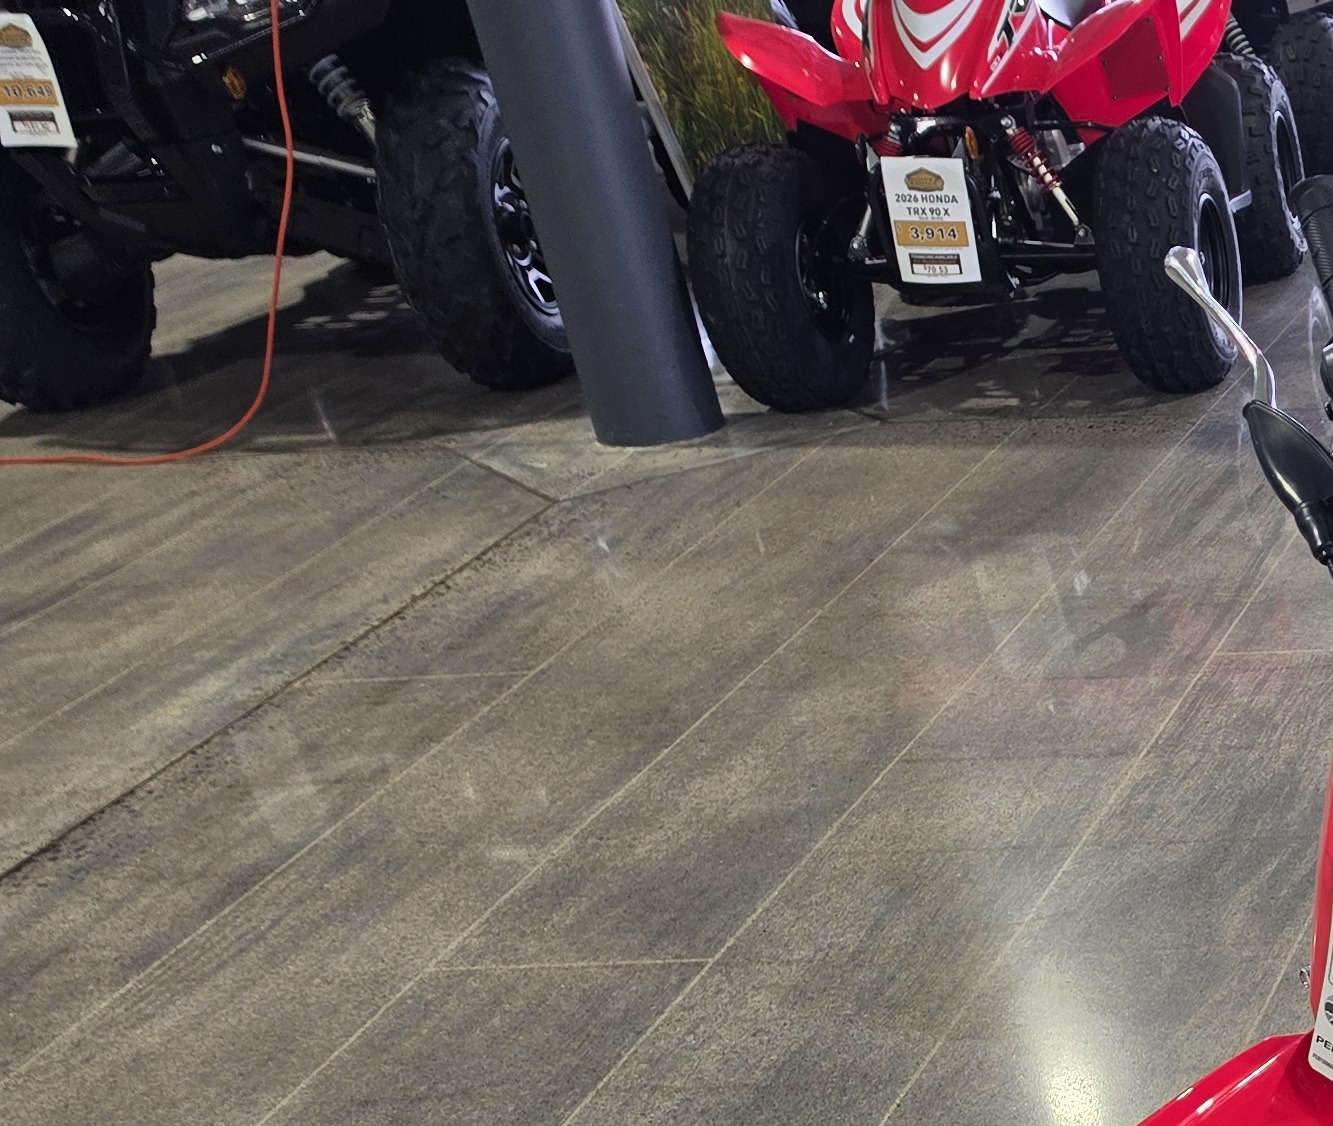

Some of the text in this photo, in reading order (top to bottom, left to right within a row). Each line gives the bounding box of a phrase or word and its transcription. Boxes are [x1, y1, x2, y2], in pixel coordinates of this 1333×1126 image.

[895, 193, 959, 204] 2026 HONDA
[906, 207, 927, 216] TRX
[943, 208, 950, 217] X
[910, 226, 957, 240] 3,914
